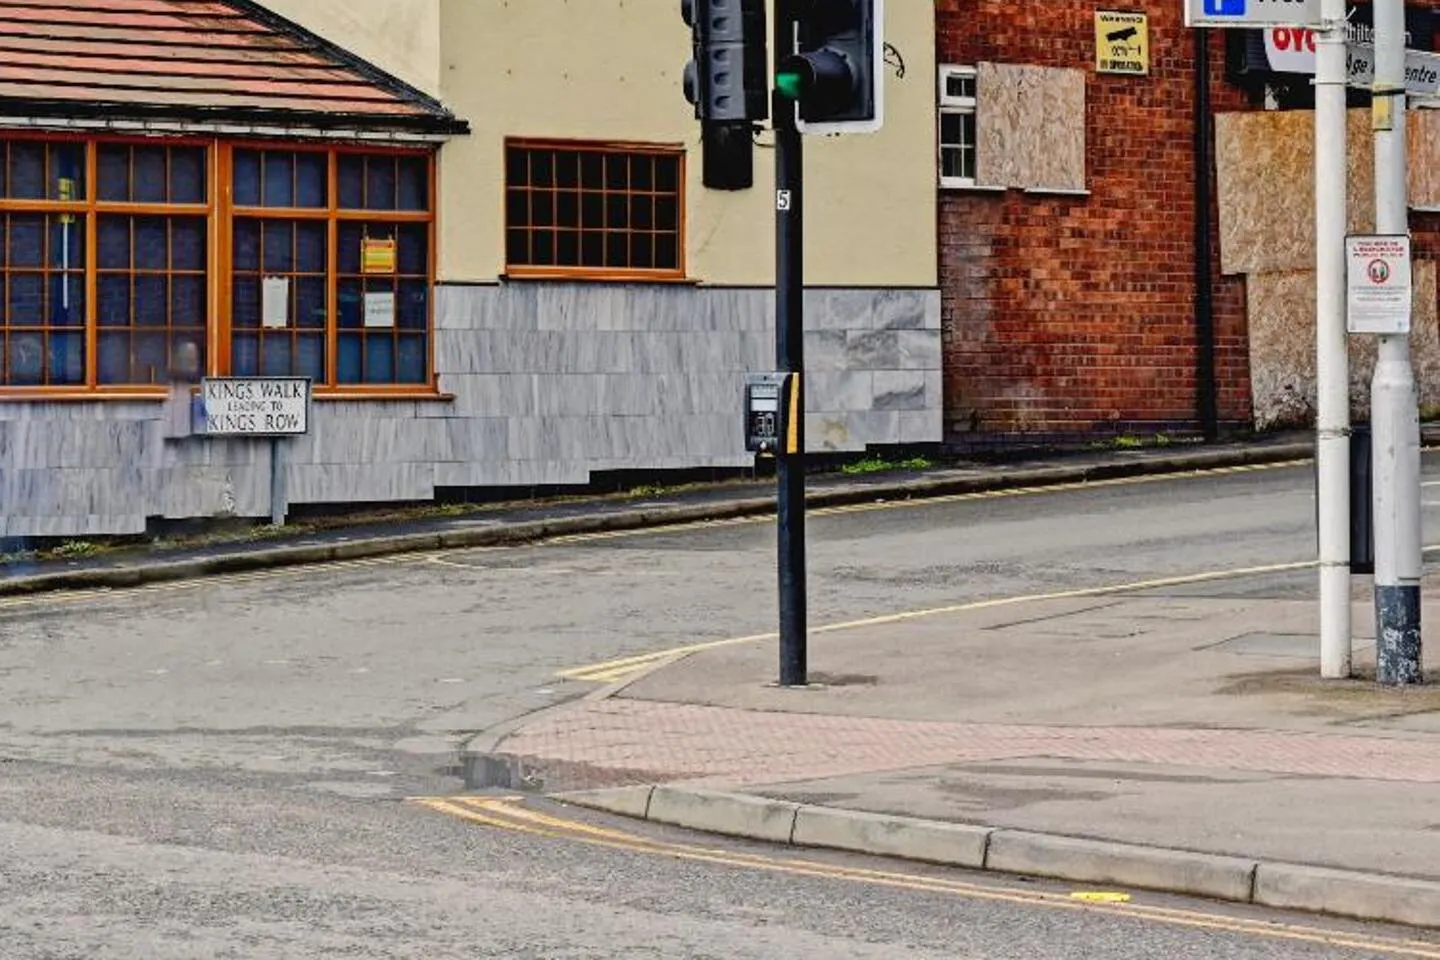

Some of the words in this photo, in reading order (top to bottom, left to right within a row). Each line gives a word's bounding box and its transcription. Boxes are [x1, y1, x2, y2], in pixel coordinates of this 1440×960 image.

[1405, 65, 1437, 83] entre
[779, 191, 788, 208] 5
[208, 382, 253, 399] KINGS
[260, 382, 302, 398] WALK
[271, 400, 283, 412] TO
[207, 414, 256, 431] KINGS
[265, 413, 299, 430] ROW
